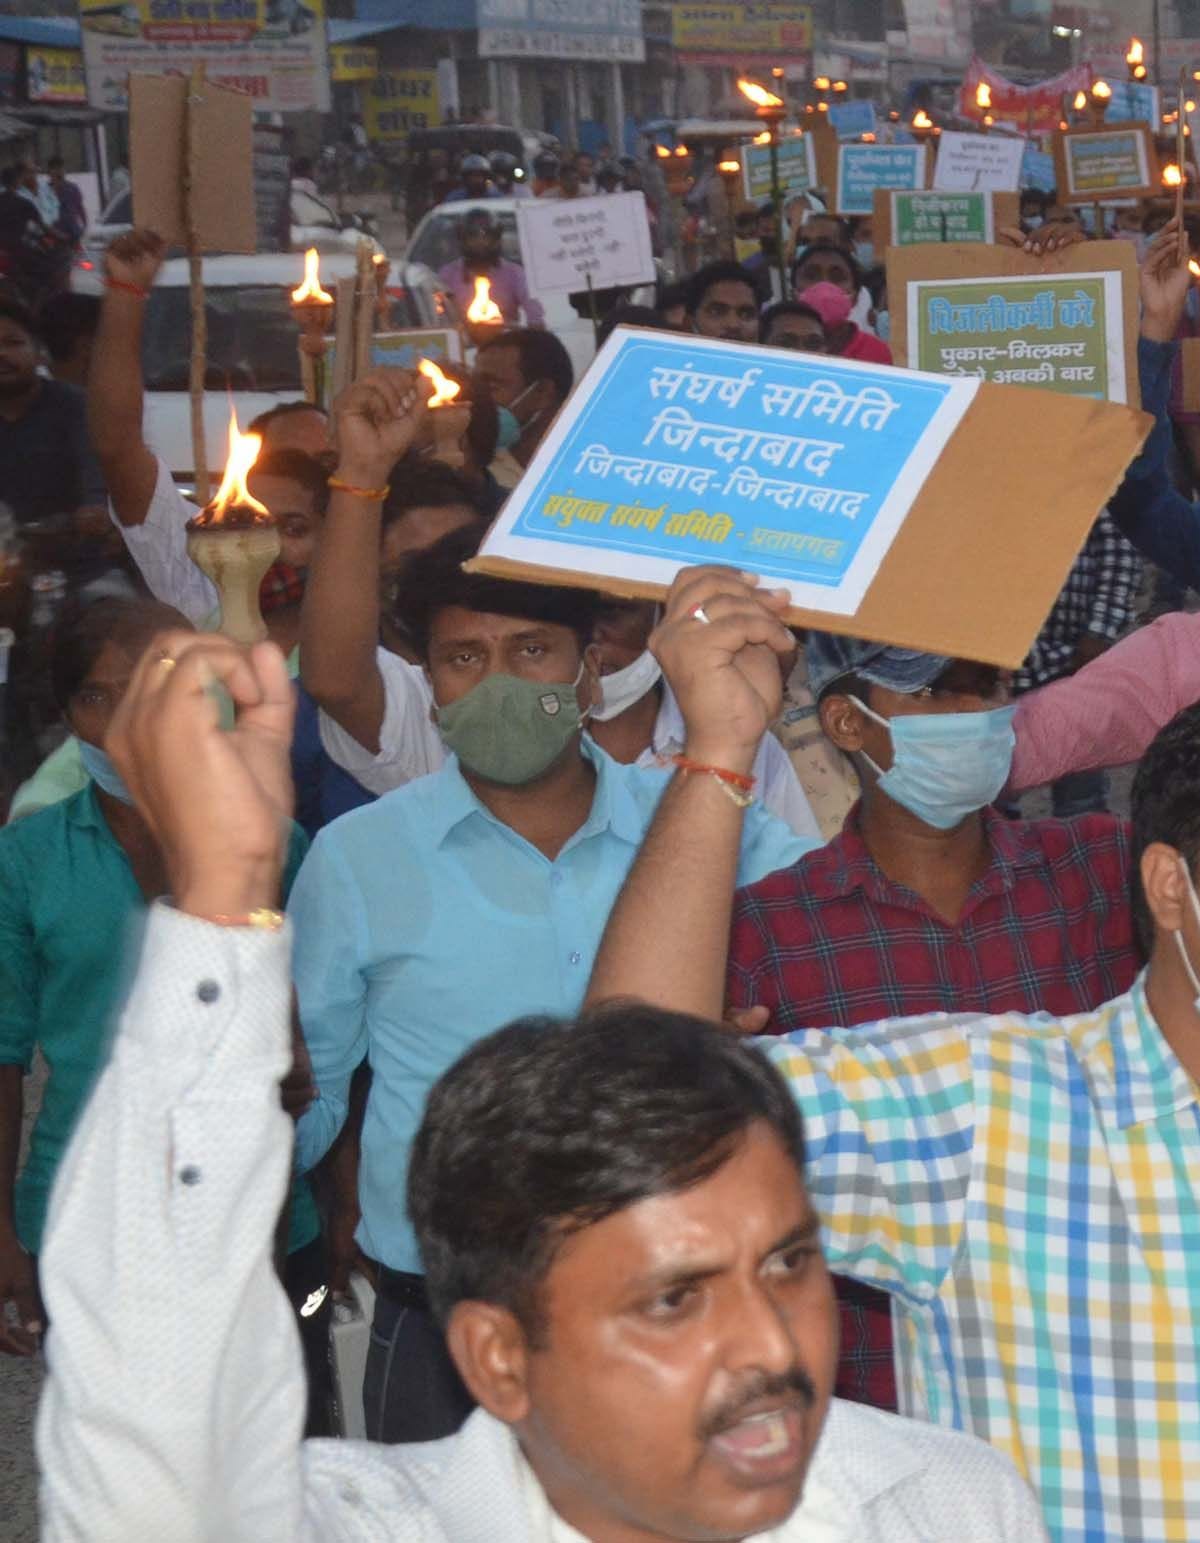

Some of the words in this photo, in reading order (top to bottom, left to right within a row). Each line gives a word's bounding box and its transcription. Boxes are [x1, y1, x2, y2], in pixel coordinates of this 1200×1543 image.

[940, 340, 1086, 369] पुकार-मिलकर
[648, 362, 763, 409] संघर्ष
[762, 382, 900, 432] समिति
[642, 406, 845, 477] जिन्दाबाद
[542, 489, 610, 528] संयुक्त
[609, 499, 668, 533] संघर्ष
[664, 510, 735, 544] समिति
[573, 444, 869, 520] जिन्दाबाद-जिन्दाबाद
